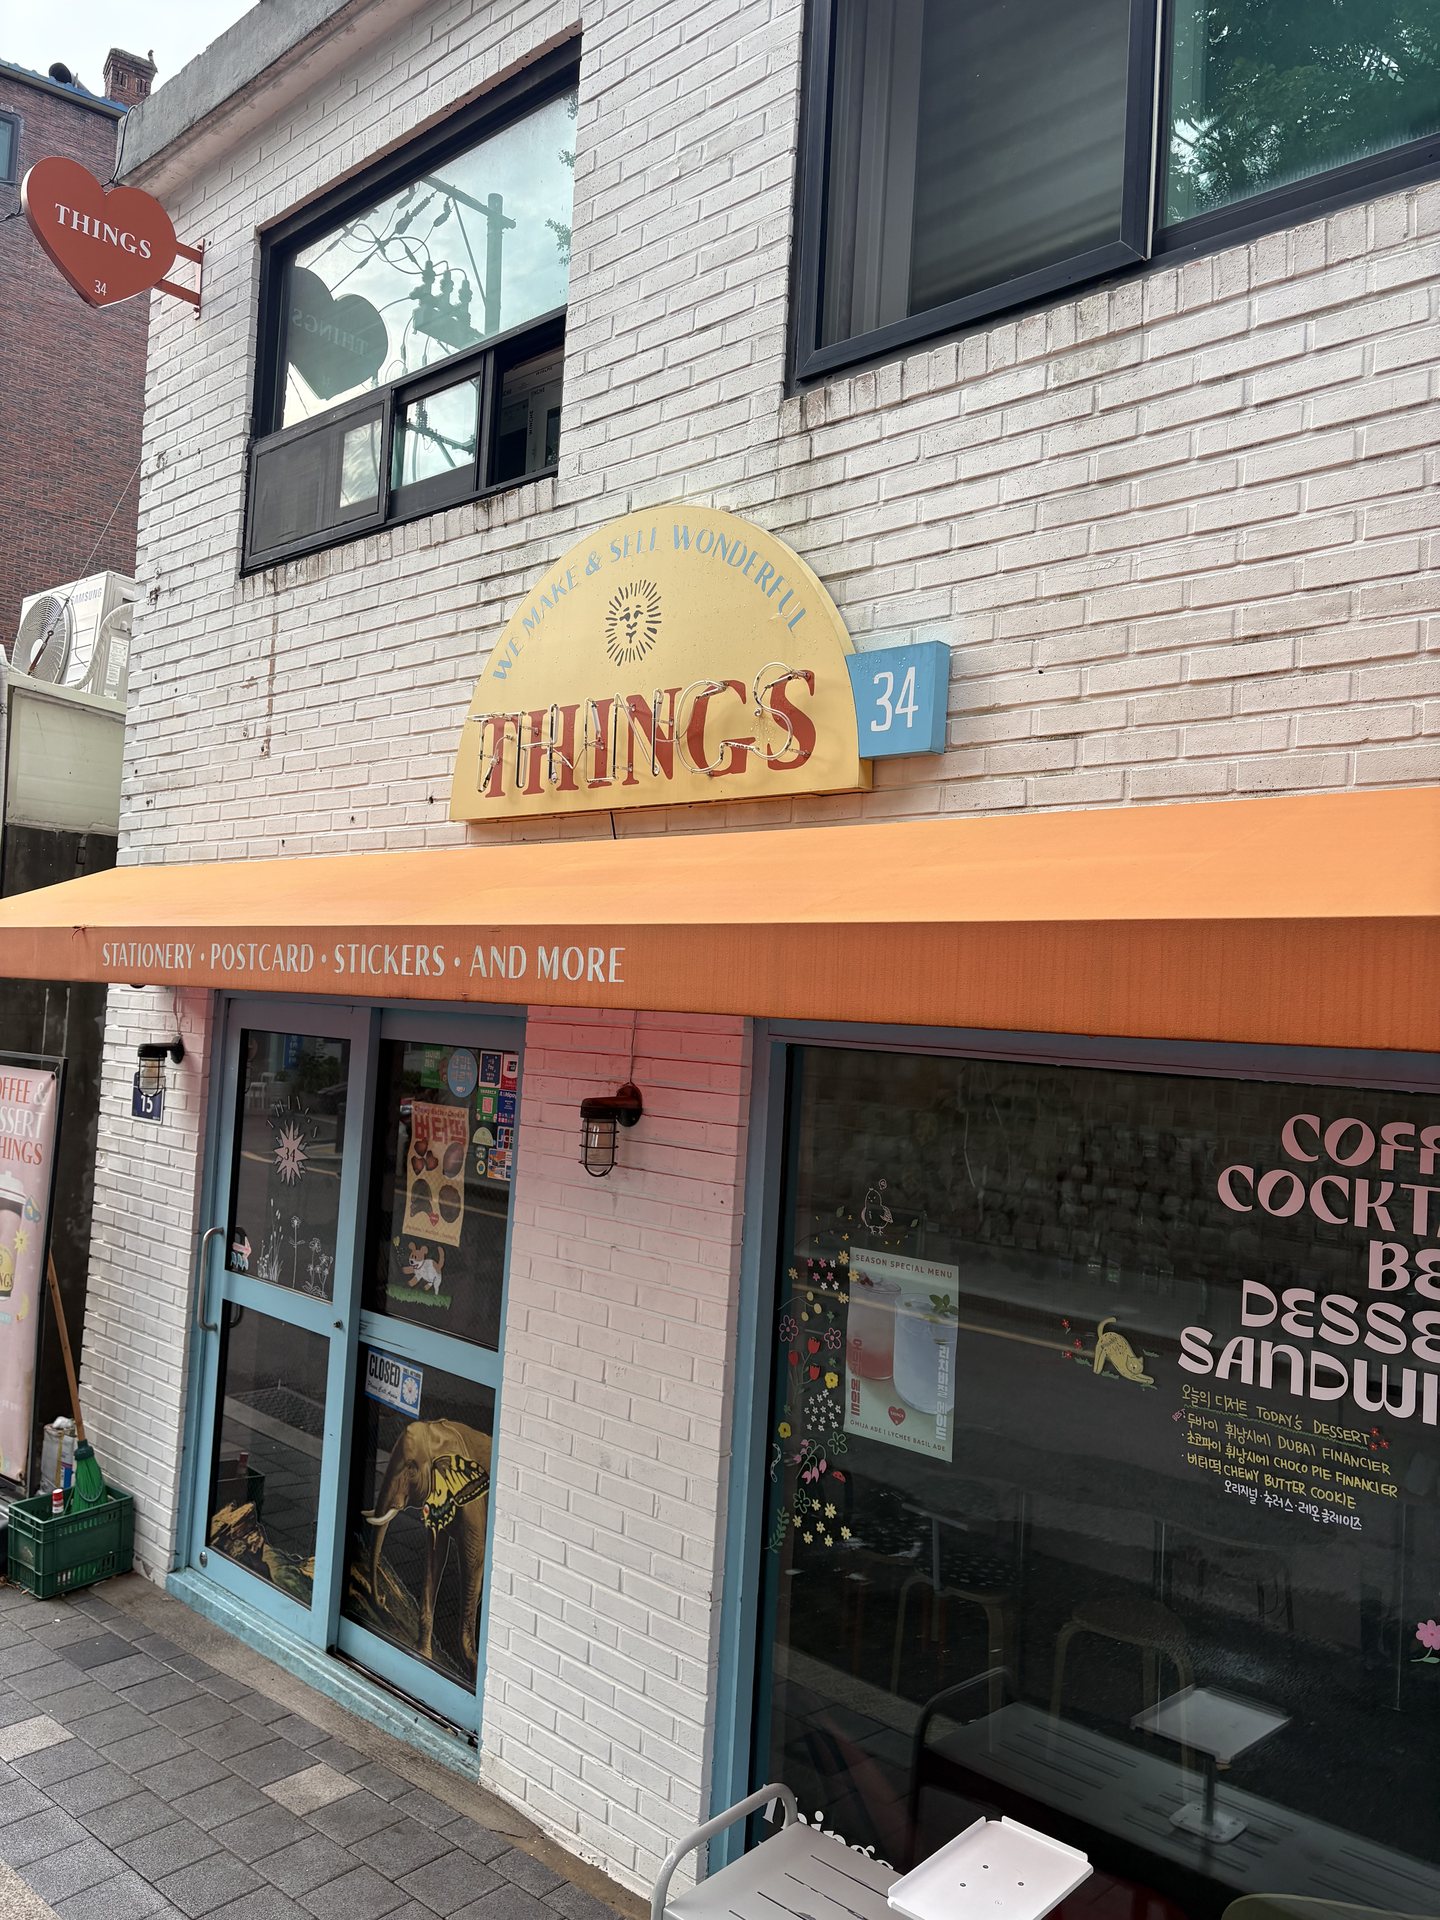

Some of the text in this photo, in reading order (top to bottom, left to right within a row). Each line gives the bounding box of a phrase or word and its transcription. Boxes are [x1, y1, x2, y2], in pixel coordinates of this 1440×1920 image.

[54, 202, 153, 260] THINGS
[93, 279, 108, 296] 34
[70, 587, 103, 605] SAMSUNG
[493, 523, 808, 681] WE MAKE & SELL WONDERFUL
[870, 666, 920, 733] 34
[476, 667, 817, 800] THINGS
[102, 942, 626, 983] STATIONERY POSTCARD STICKERS AND MORE
[33, 1082, 48, 1106] &
[140, 1095, 154, 1114] 15
[414, 1113, 467, 1146] 버터떡
[284, 1146, 296, 1163] 34
[1217, 1164, 1440, 1240] COCKT
[855, 1253, 953, 1280] SEASON SPECIAL MENU
[369, 1355, 401, 1387] CLOSED
[1177, 1325, 1438, 1427] SANDWI
[1171, 1408, 1186, 1421] BEST
[1182, 1384, 1370, 1445] 오늘의 디저트 TODAY'S DESSERT
[1187, 1413, 1391, 1476] 두바이 휘낭시에 DUBAI FINANCIER
[1187, 1431, 1399, 1499] 초코파이 휘낭시에 CHOCO PIE FINANCIER
[1187, 1452, 1357, 1510] 버터떡 CHEWY BUTTER COOKIE
[1224, 1479, 1259, 1505] 오리지널
